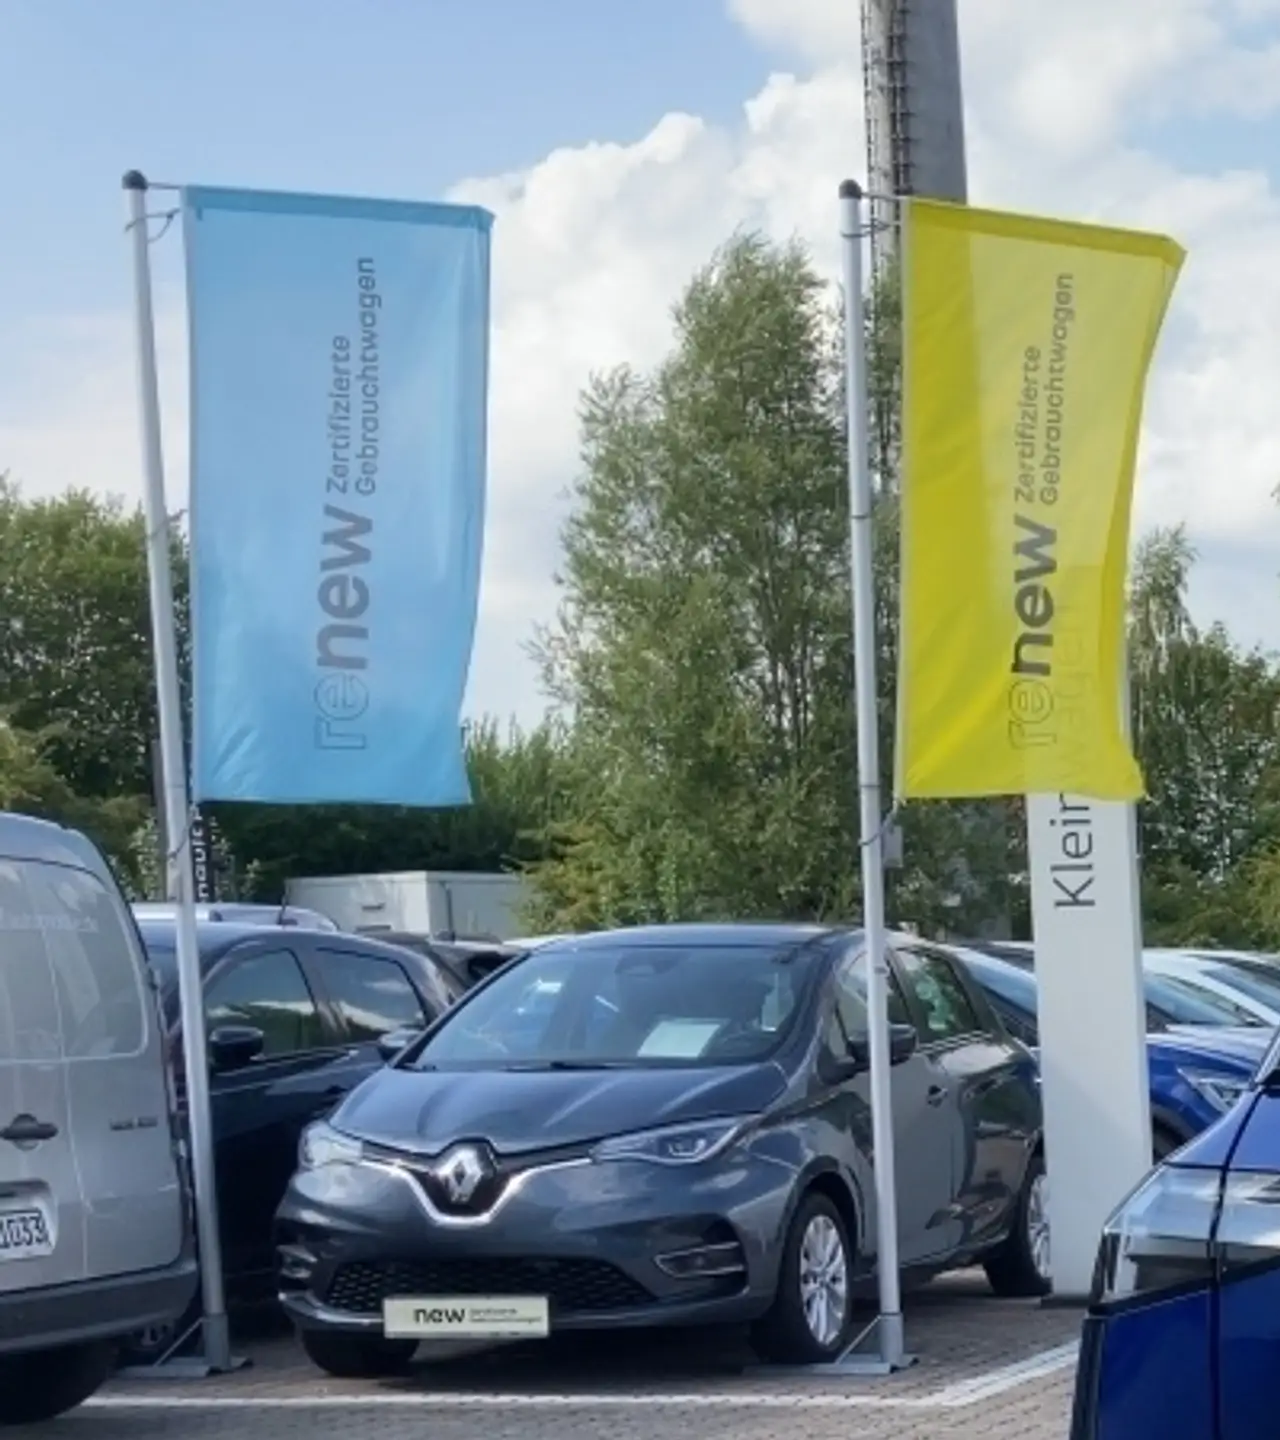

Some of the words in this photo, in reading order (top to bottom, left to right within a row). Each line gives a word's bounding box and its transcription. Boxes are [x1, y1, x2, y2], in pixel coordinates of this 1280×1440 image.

[325, 334, 351, 495] Zertifizierte
[355, 256, 382, 497] Gebrauchtwagen
[1012, 345, 1042, 505] Zertifizierte
[1039, 272, 1075, 506] Gebrauchtwagen
[313, 502, 374, 751] renew
[1007, 513, 1058, 751] renew
